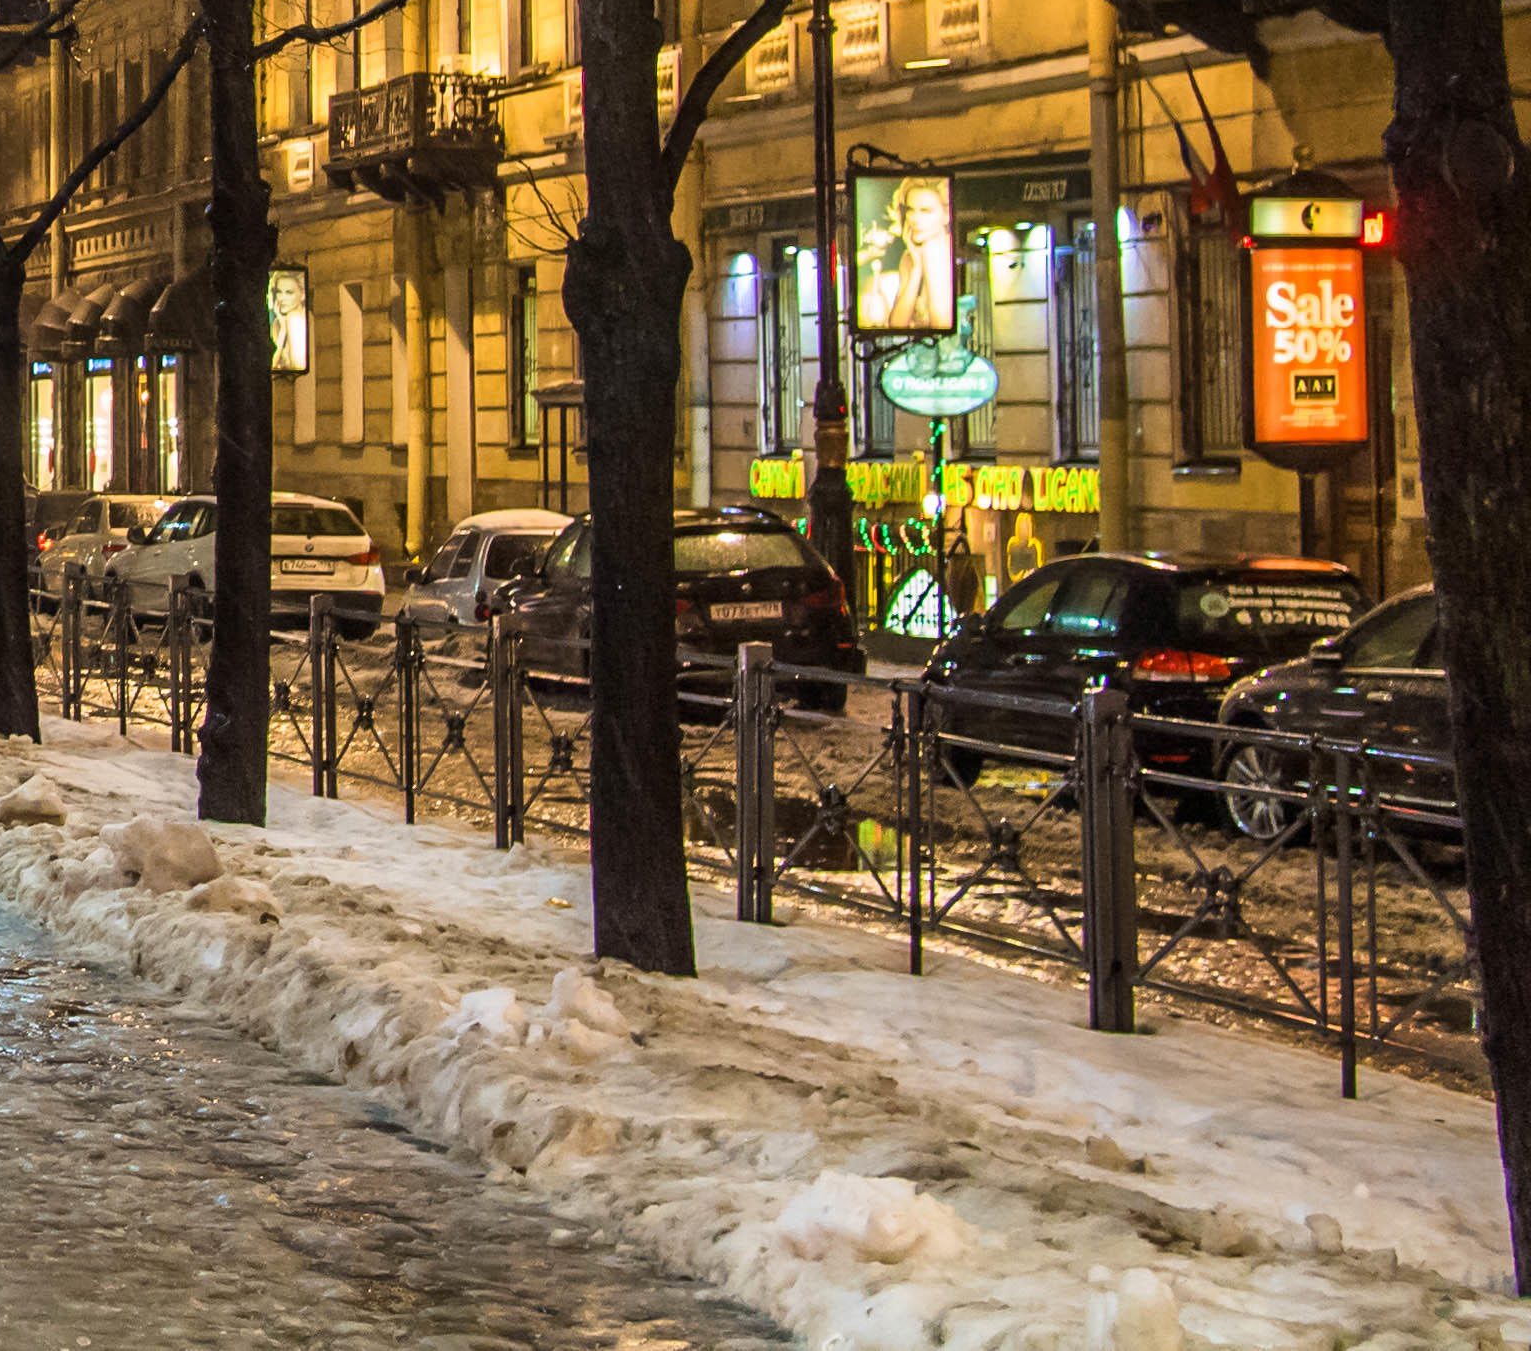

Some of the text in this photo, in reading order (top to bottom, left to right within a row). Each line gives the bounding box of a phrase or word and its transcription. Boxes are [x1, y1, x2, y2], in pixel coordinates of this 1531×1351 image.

[1265, 279, 1356, 329] Sale
[1272, 328, 1352, 364] 50%
[750, 449, 806, 499] САМЫЙ
